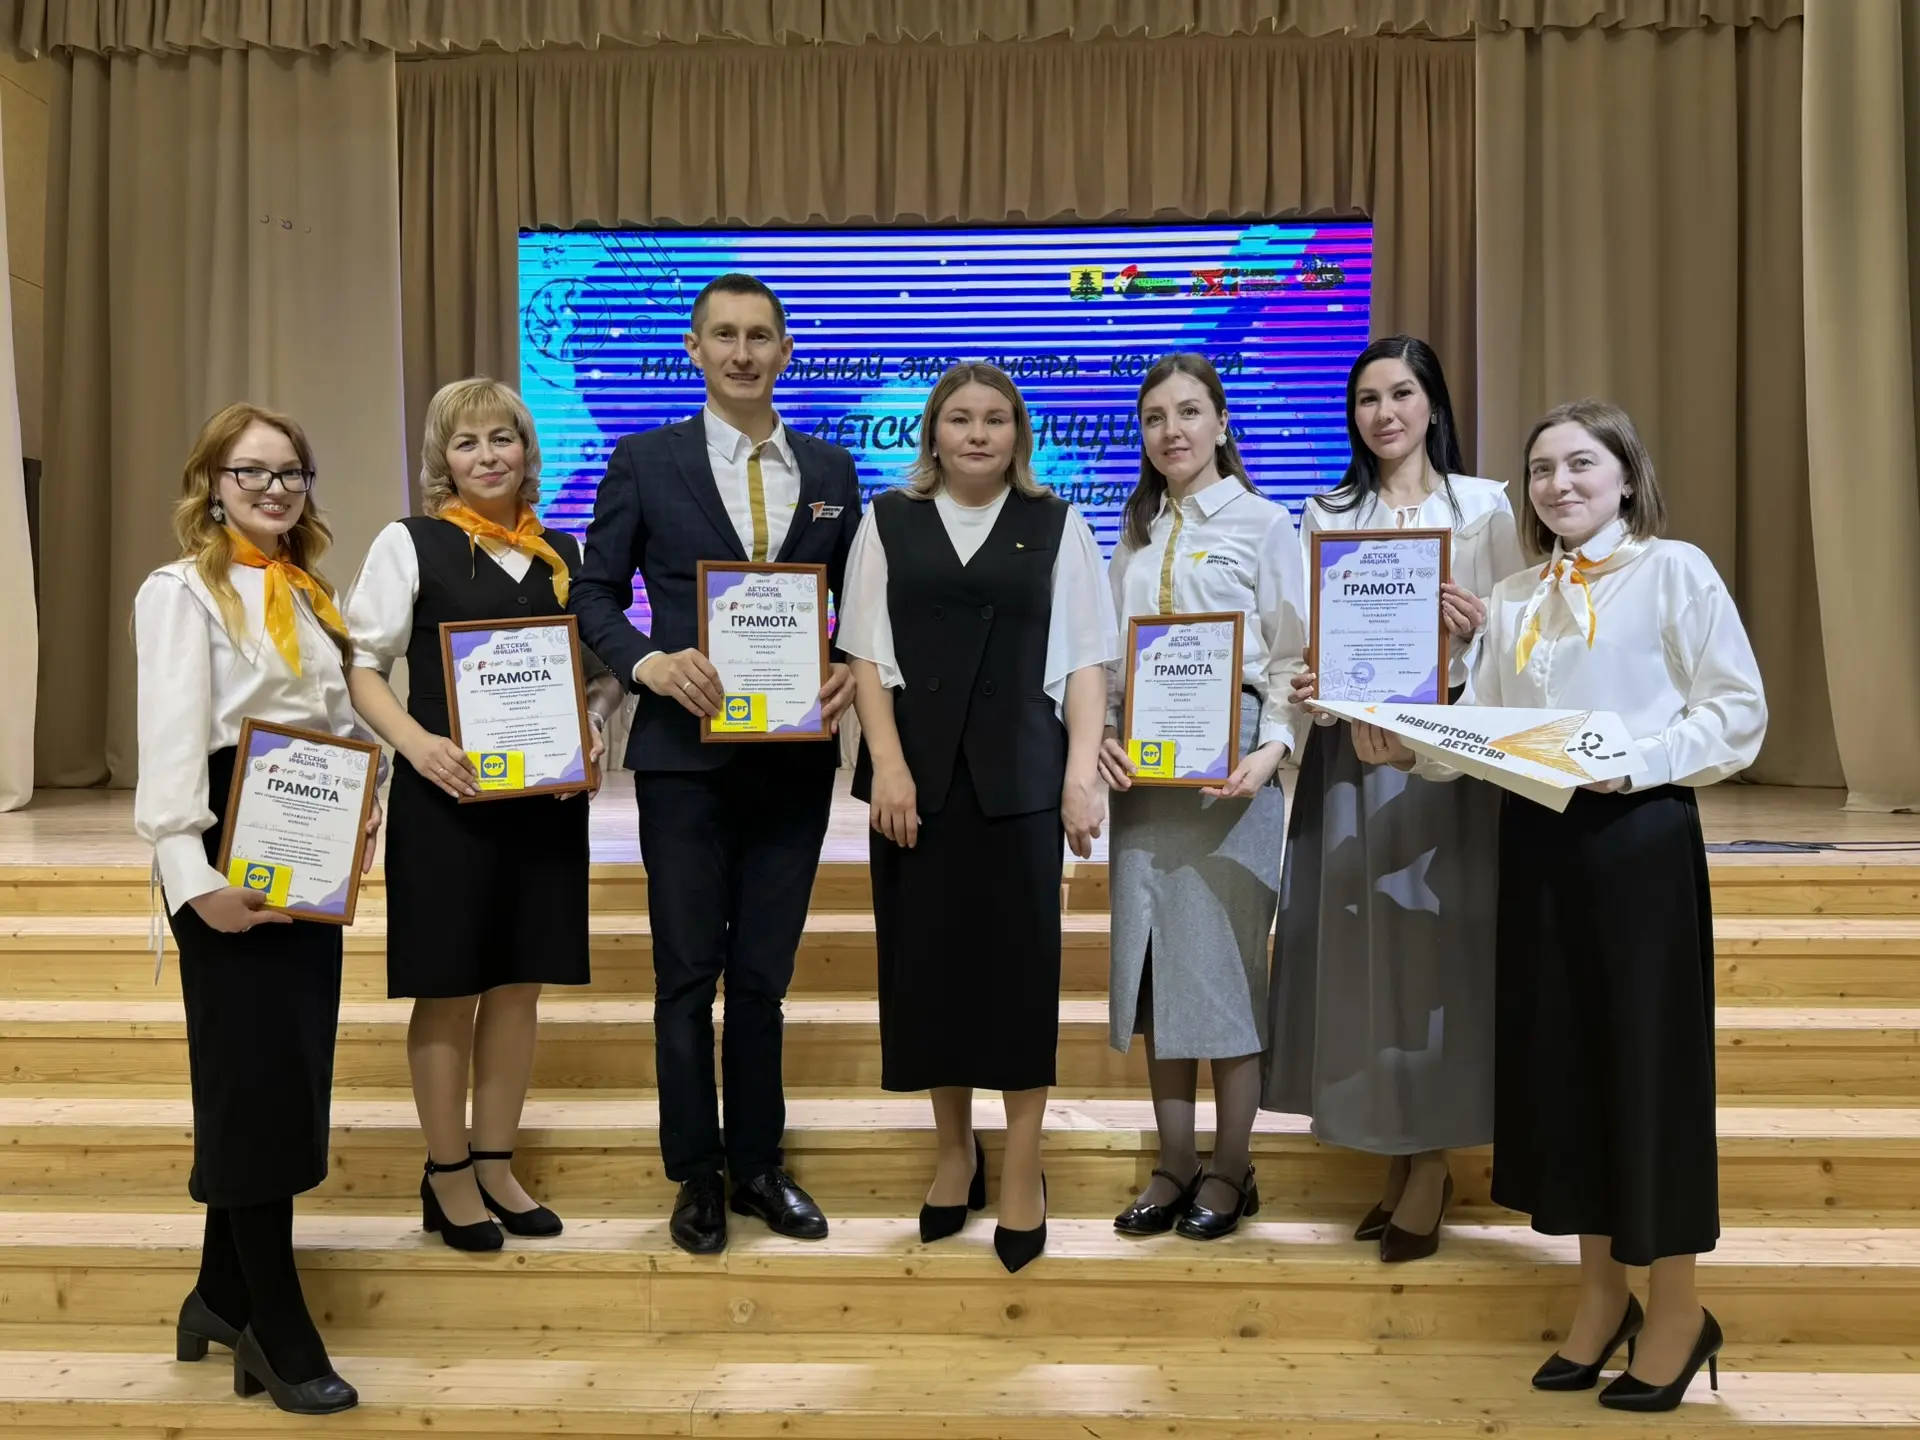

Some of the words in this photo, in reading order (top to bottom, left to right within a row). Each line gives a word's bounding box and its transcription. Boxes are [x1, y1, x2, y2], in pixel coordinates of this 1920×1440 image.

[1344, 583, 1416, 596] ГРАМОТА
[731, 615, 798, 628] ГРАМОТА
[493, 647, 532, 655] ИНИЦИАТИВ
[495, 642, 529, 650] ДЕТСКИХ
[1154, 663, 1213, 676] ГРАМОТА
[480, 669, 551, 686] ГРАМОТА
[1395, 713, 1490, 745] НАВИГАТОРЫ
[1438, 738, 1506, 761] ДЕТСТВА
[288, 757, 328, 769] ИНИЦИАТИВ
[292, 752, 327, 764] ДЕТСКИХ
[267, 778, 339, 803] ГРАМОТА
[249, 874, 270, 882] ФРГ
